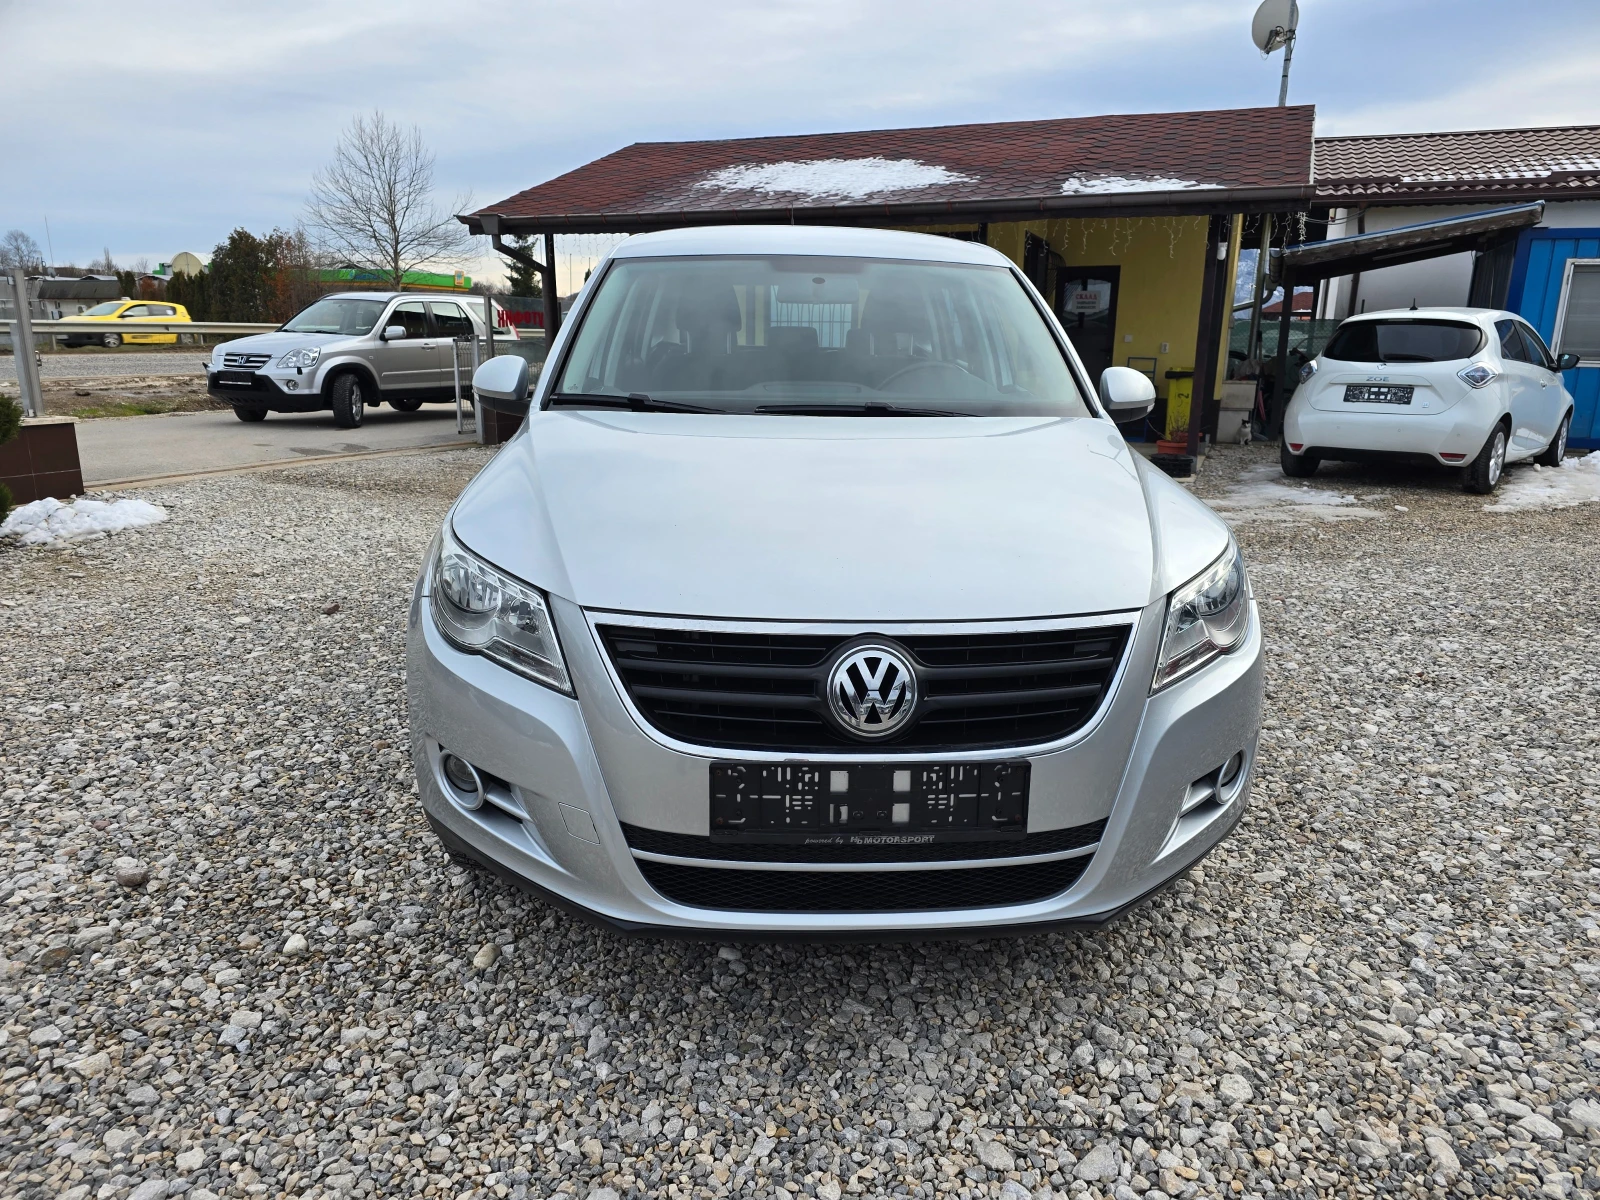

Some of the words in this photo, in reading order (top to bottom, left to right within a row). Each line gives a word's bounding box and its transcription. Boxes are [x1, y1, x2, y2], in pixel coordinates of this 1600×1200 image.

[827, 644, 918, 737] VW
[804, 837, 833, 845] powered
[835, 836, 844, 845] by
[863, 835, 935, 845] MOTORSPORT
